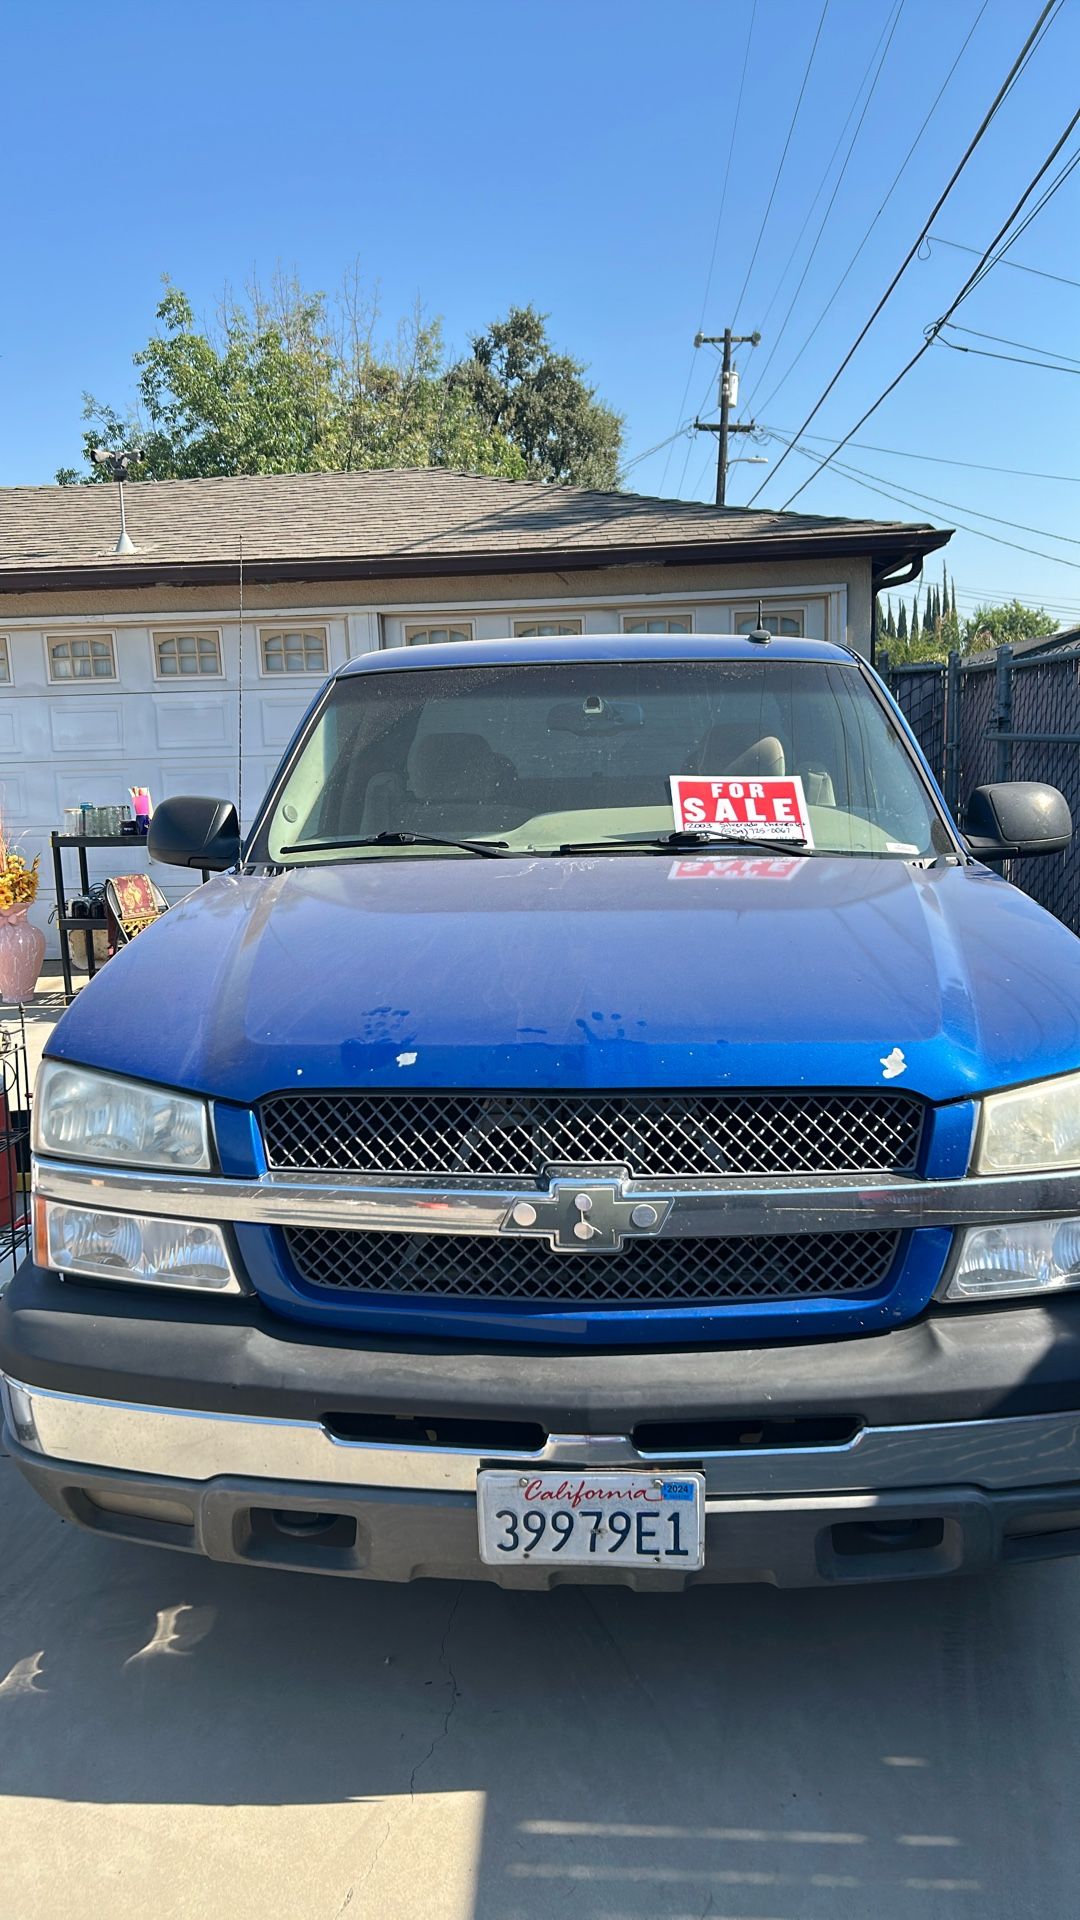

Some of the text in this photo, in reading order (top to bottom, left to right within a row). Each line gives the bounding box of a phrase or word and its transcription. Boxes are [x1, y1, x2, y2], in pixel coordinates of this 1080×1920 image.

[711, 783, 765, 798] FOR
[683, 797, 796, 822] SALE
[525, 1479, 662, 1508] California
[667, 1485, 689, 1493] 2024
[496, 1510, 689, 1555] 39979E1
